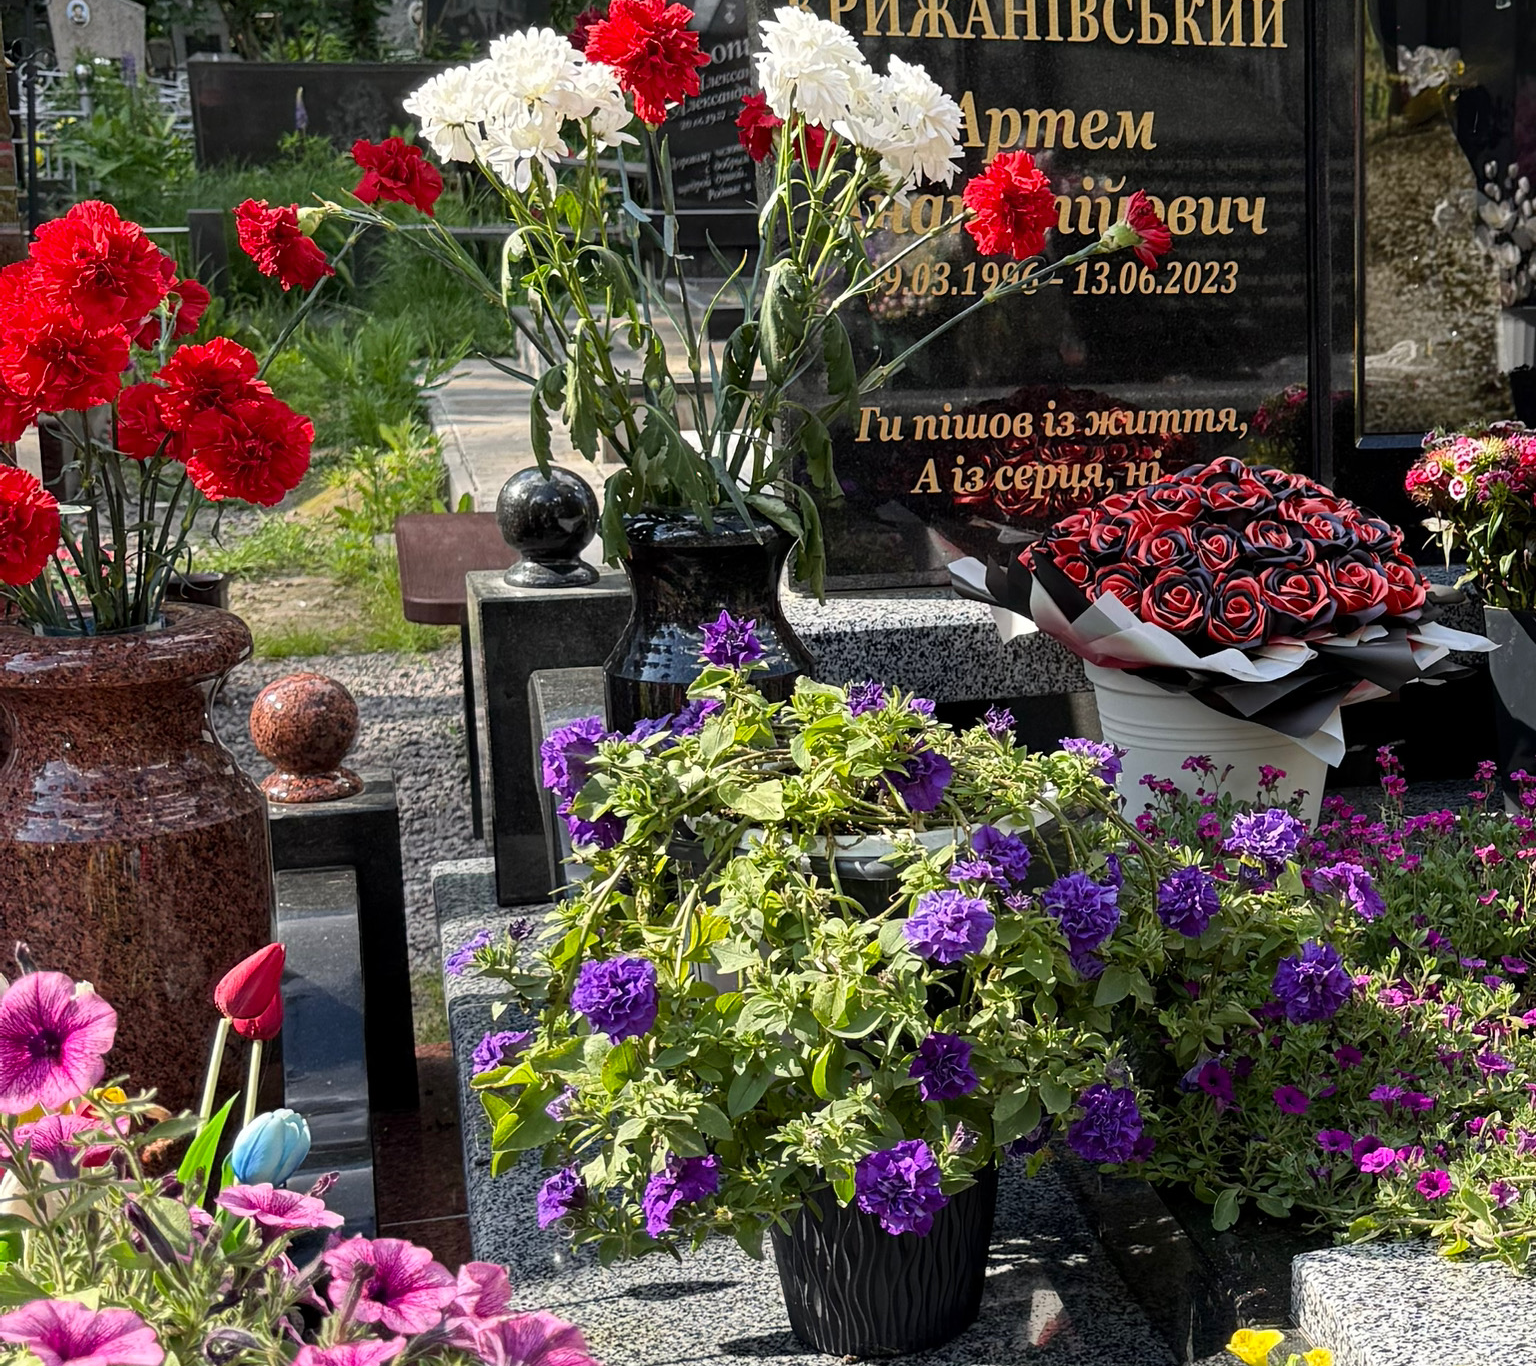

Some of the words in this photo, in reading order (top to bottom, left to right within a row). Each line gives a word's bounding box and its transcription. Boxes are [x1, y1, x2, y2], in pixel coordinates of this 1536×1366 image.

[957, 90, 1157, 164] Артем
[872, 260, 1040, 296] 9.03.1996
[1072, 260, 1239, 296] 13.06.2023
[913, 402, 1034, 441] пішов
[1043, 400, 1075, 437] із
[1085, 407, 1248, 439] життя,
[910, 458, 942, 493] А
[951, 454, 984, 493] із
[993, 461, 1114, 500] серця,
